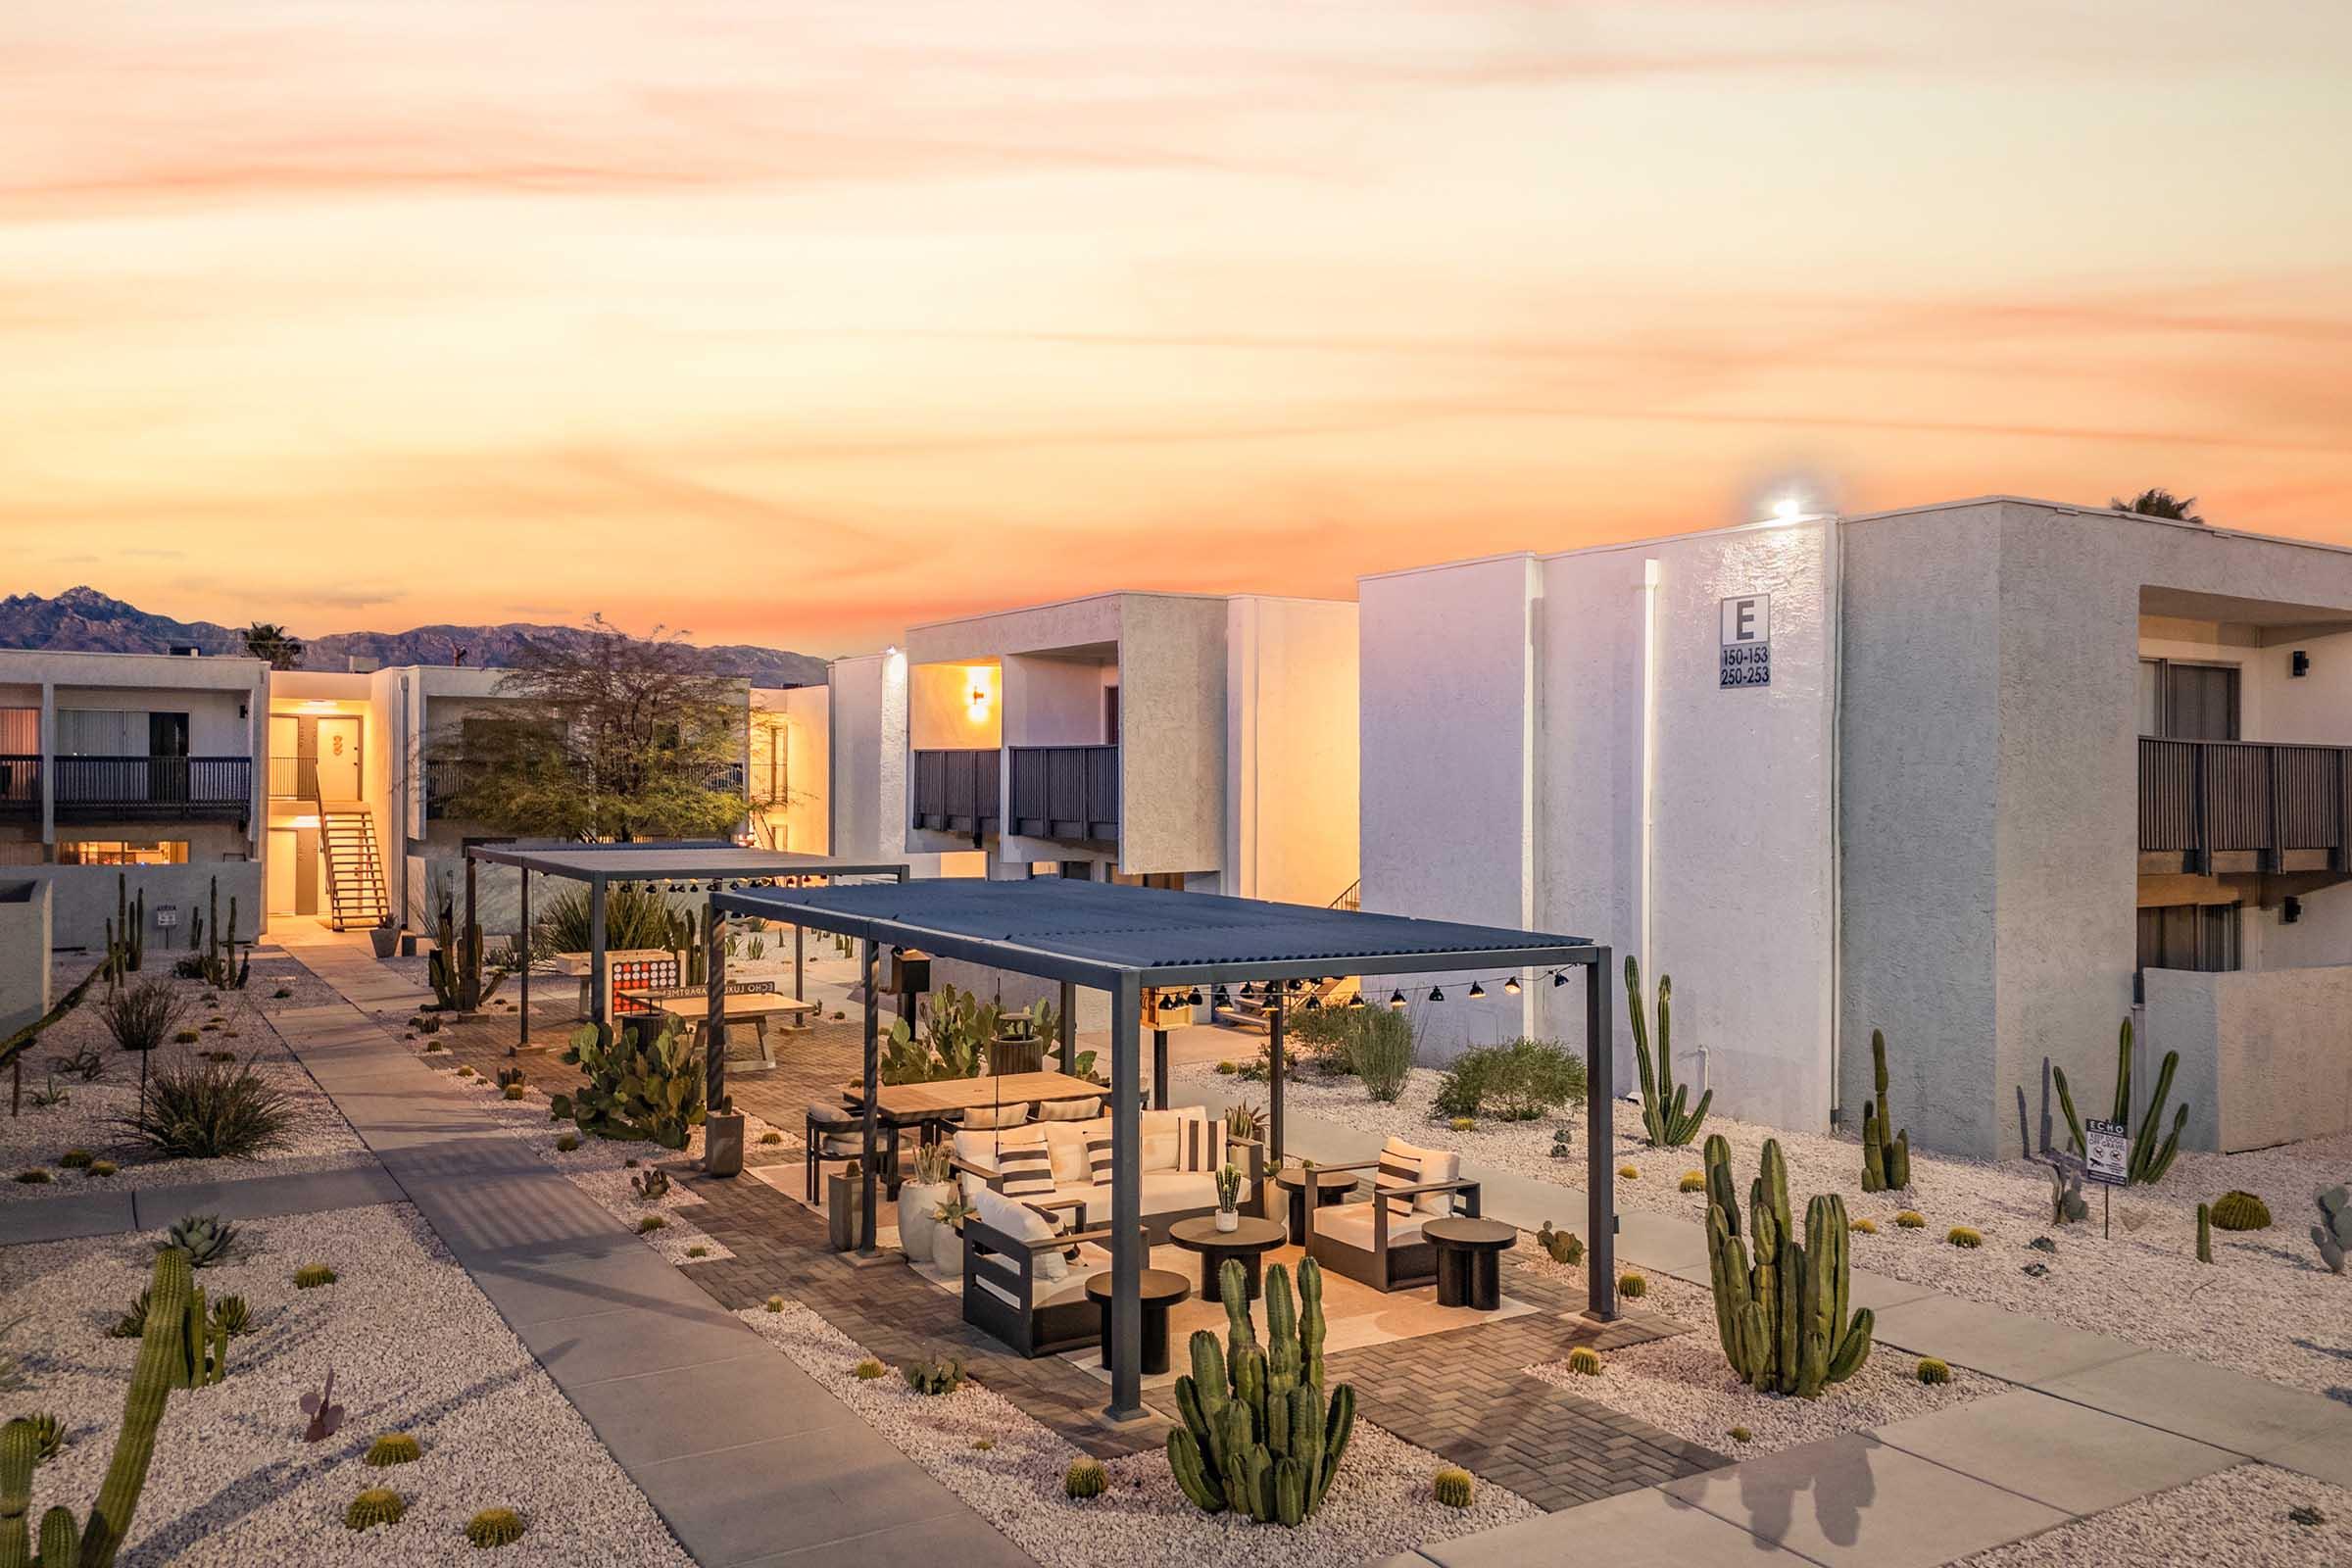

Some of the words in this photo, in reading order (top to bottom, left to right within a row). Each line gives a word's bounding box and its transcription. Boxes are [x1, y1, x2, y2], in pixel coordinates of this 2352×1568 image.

[1737, 600, 1754, 640] E
[1724, 647, 1768, 665] 150-153
[1721, 666, 1769, 685] 250-253
[2090, 1120, 2124, 1134] ECHO
